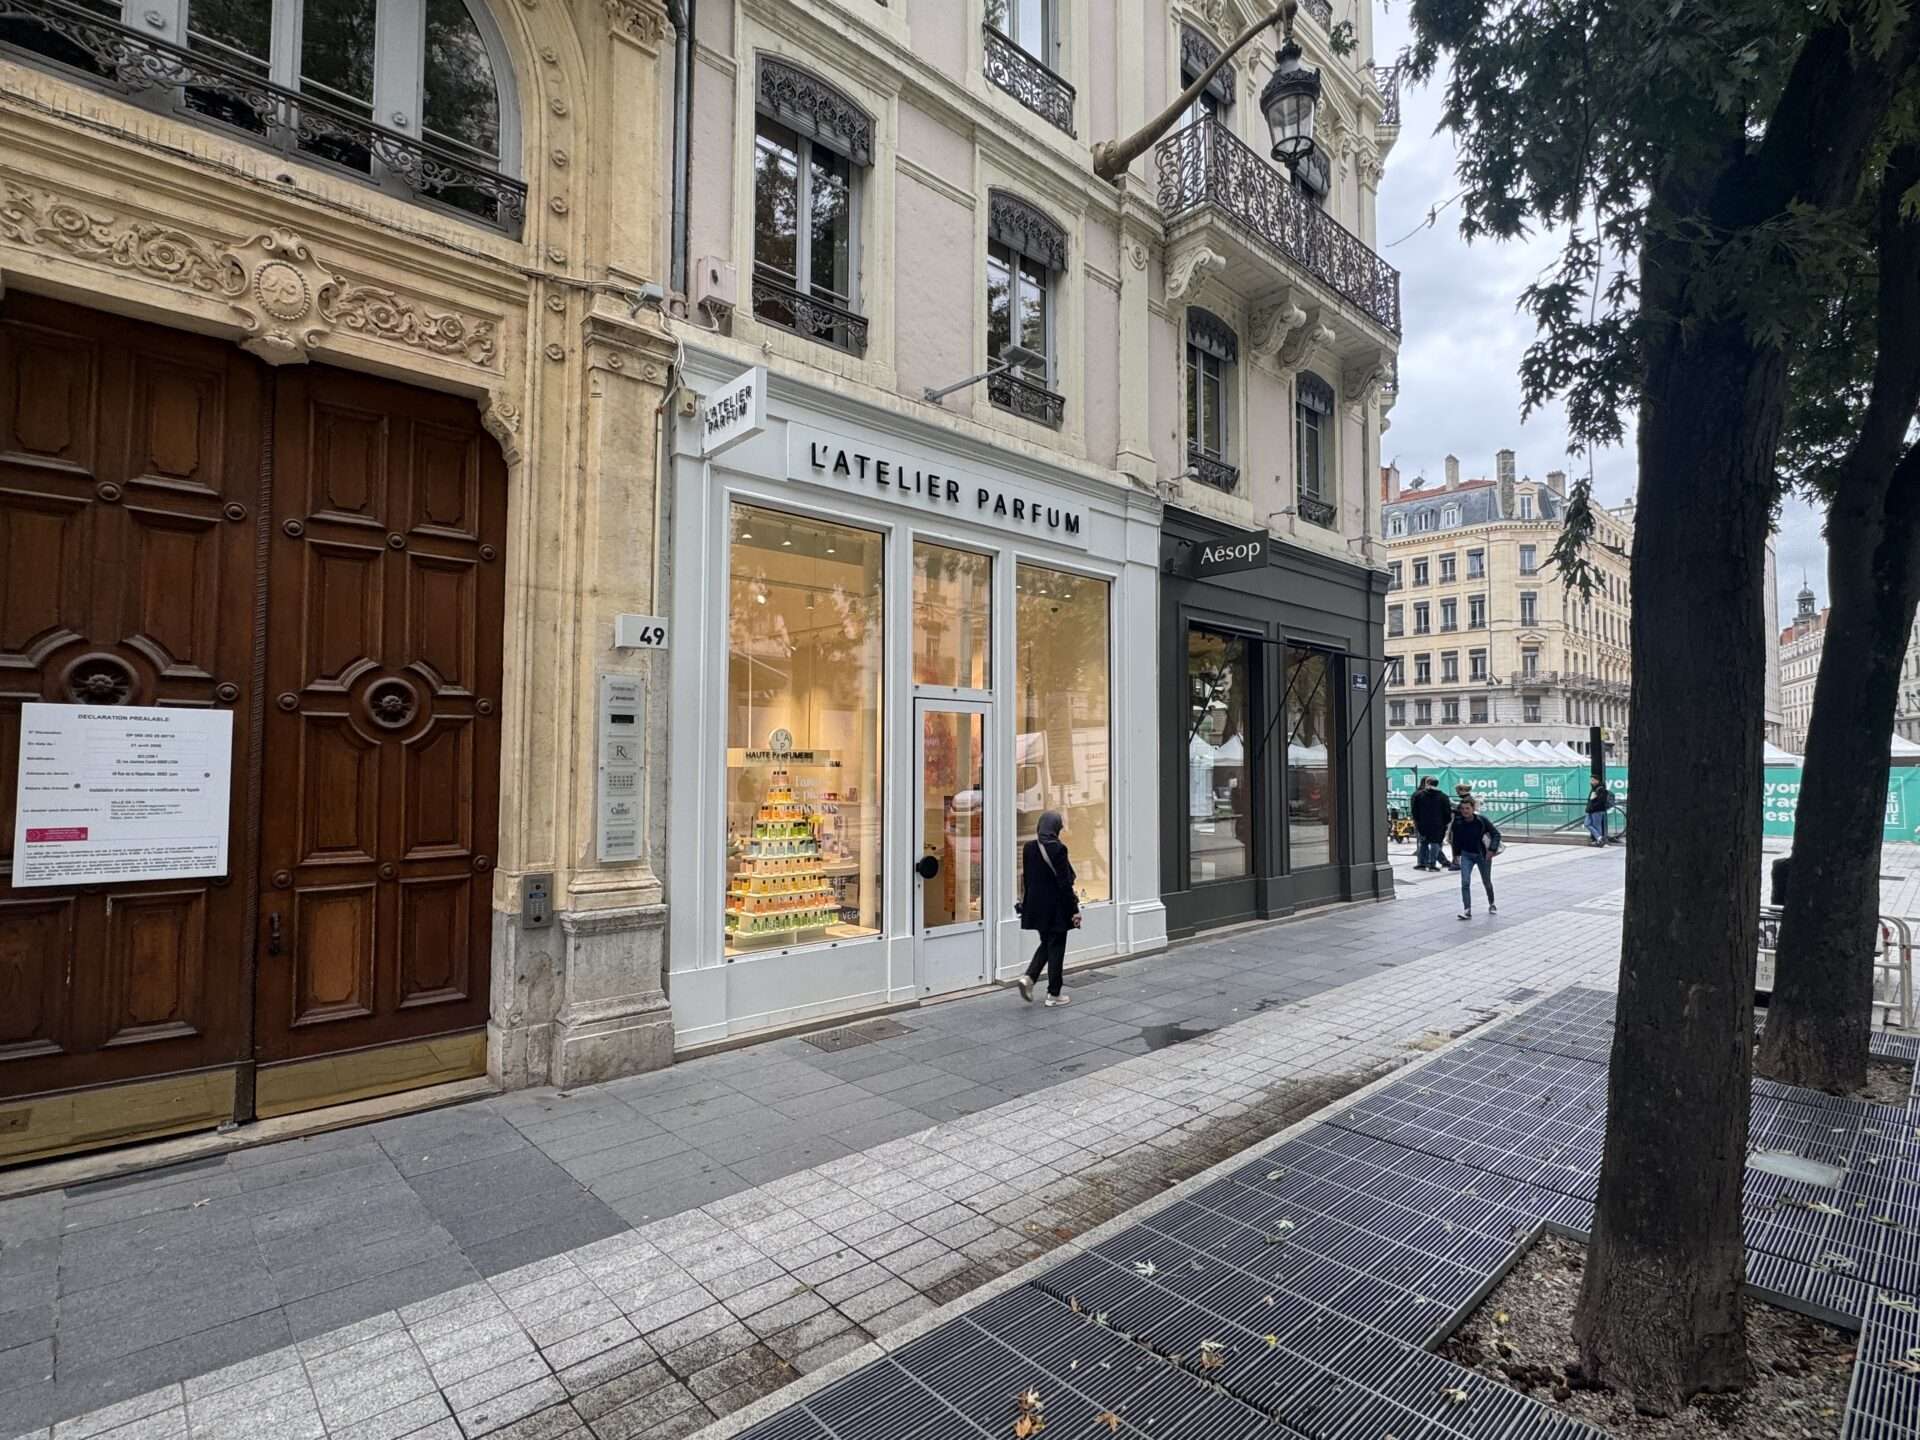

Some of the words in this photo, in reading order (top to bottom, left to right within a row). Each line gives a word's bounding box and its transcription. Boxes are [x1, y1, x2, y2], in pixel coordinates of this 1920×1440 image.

[704, 386, 752, 422] L'ATELIER
[708, 402, 748, 434] PARFUM
[811, 442, 960, 503] L'ATELIER
[977, 488, 1080, 534] PARFUM
[640, 626, 665, 645] 49
[746, 751, 770, 759] HAUTE
